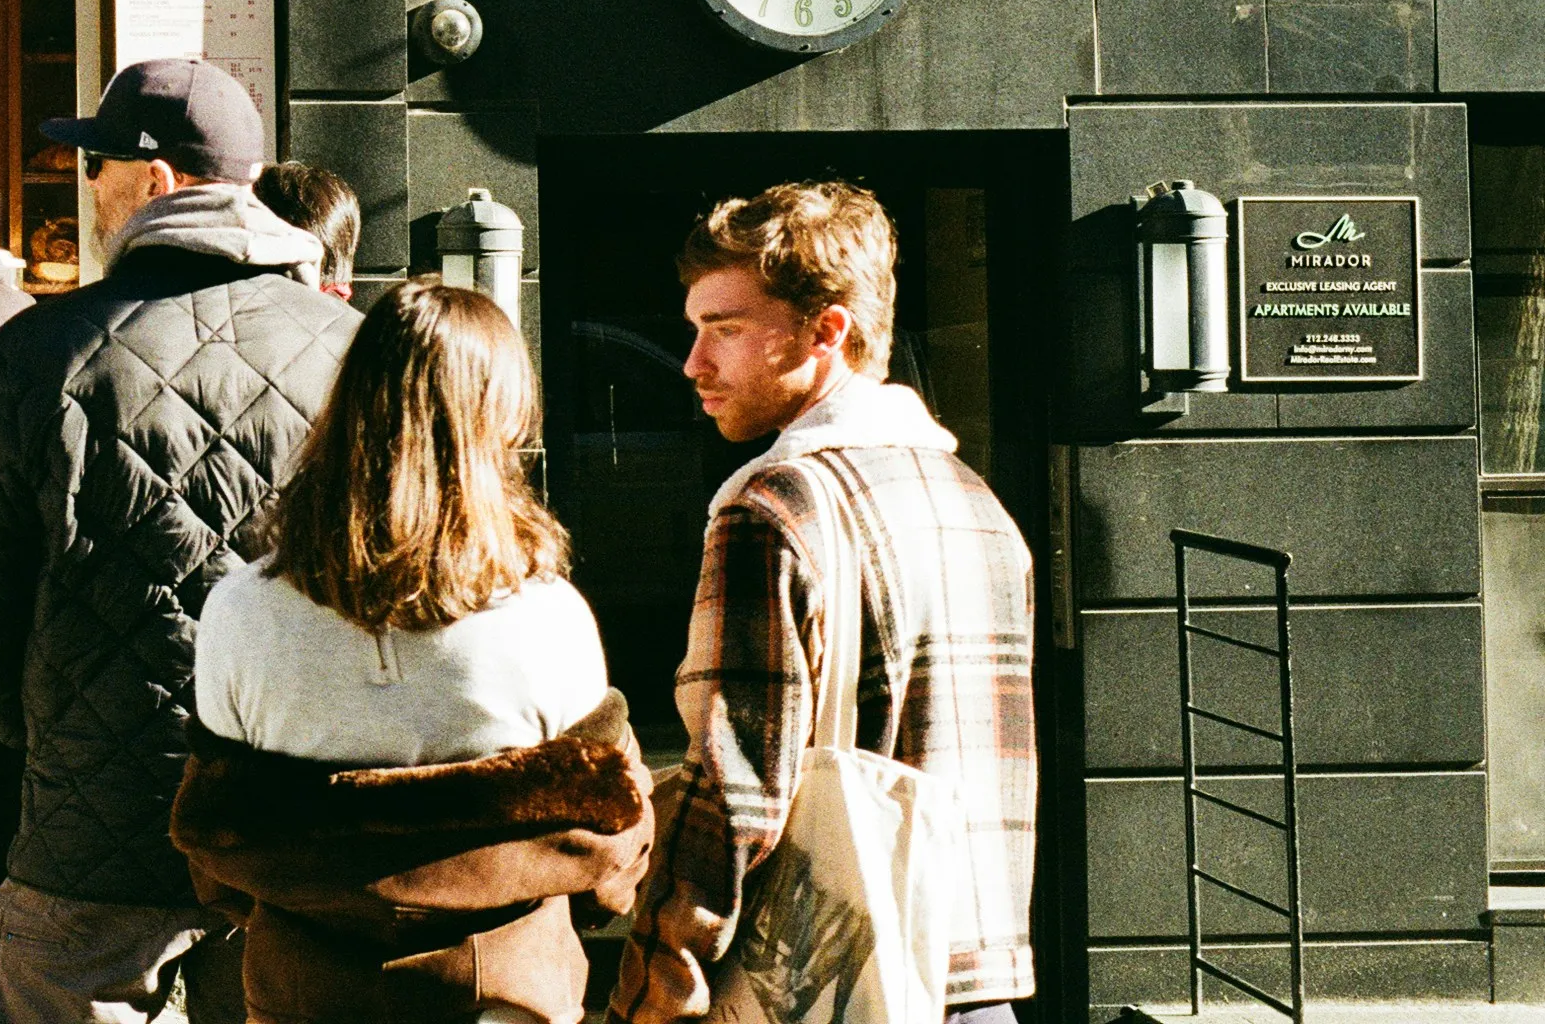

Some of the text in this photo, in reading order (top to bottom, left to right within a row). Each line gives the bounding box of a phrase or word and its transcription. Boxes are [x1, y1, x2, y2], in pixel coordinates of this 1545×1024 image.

[1291, 254, 1372, 268] MIRADOR
[1265, 281, 1397, 293] EXCLUSIVE LEASING AGENT
[1254, 302, 1411, 317] APARTMENTS AVAILABLE
